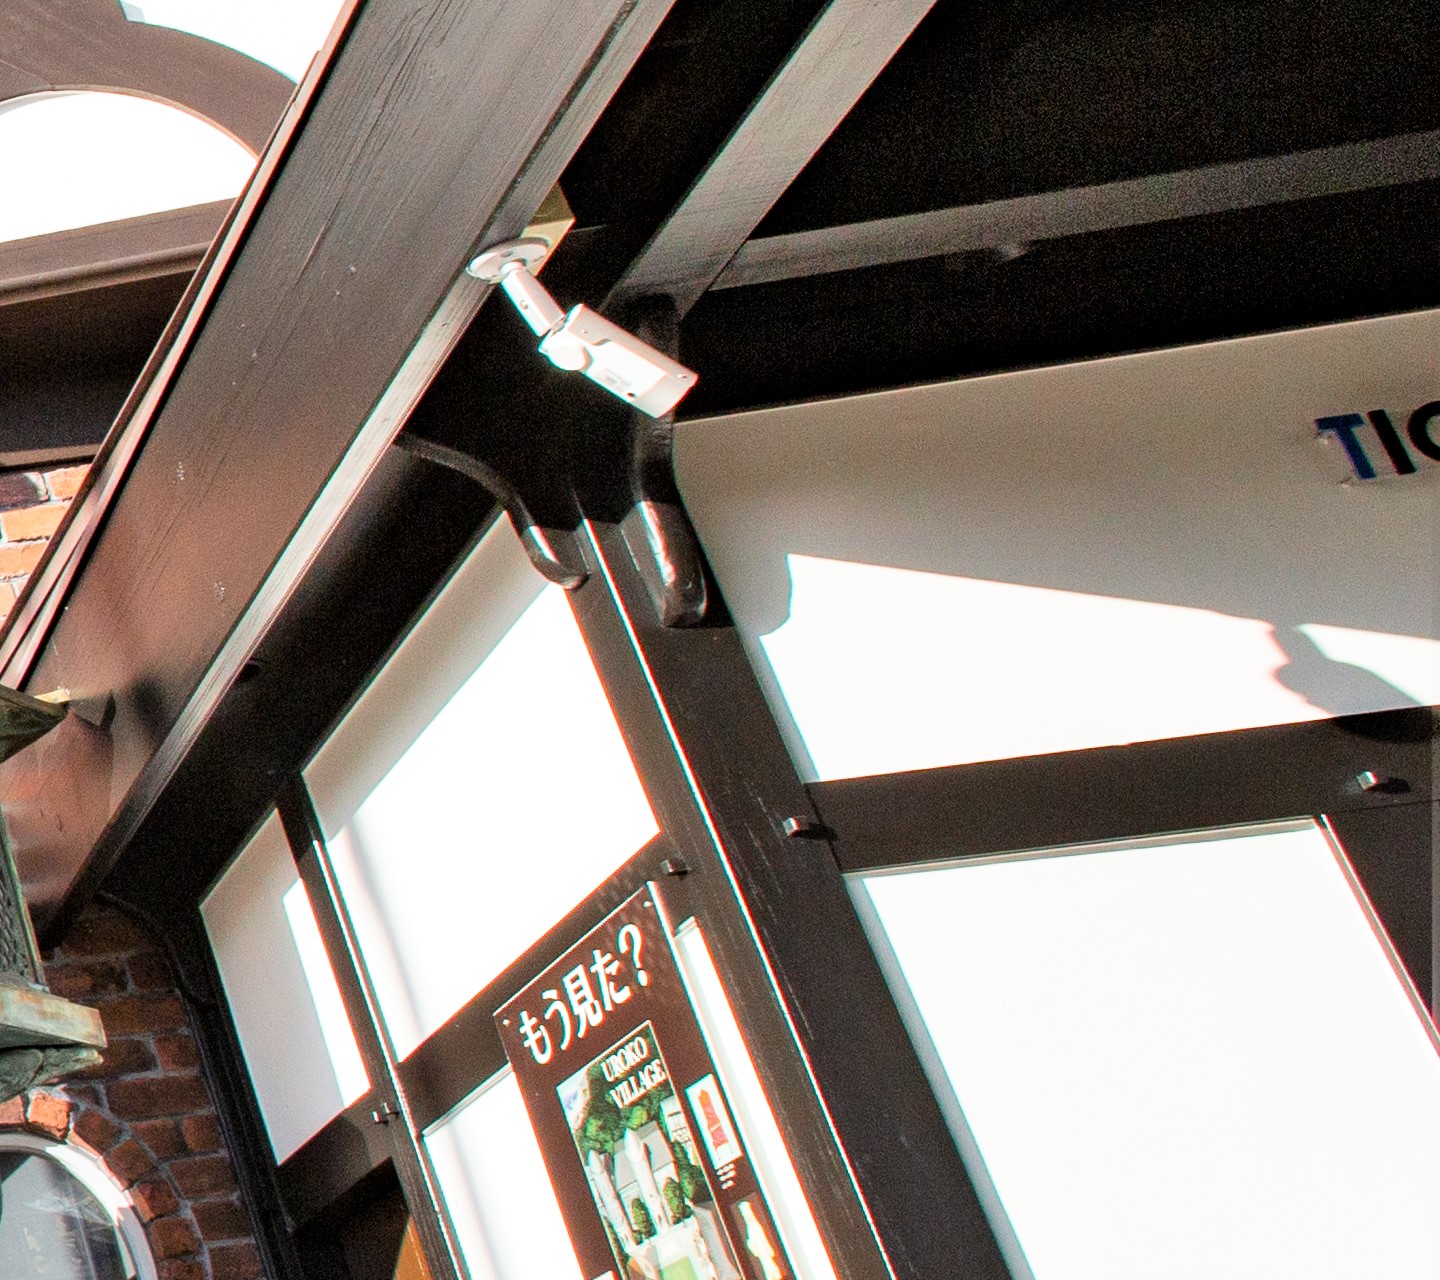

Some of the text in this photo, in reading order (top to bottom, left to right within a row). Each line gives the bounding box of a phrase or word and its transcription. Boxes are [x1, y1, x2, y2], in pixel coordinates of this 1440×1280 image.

[519, 924, 649, 1065] もう見た？
[600, 1036, 648, 1082] UROKO
[609, 1058, 667, 1108] VILLAGE
